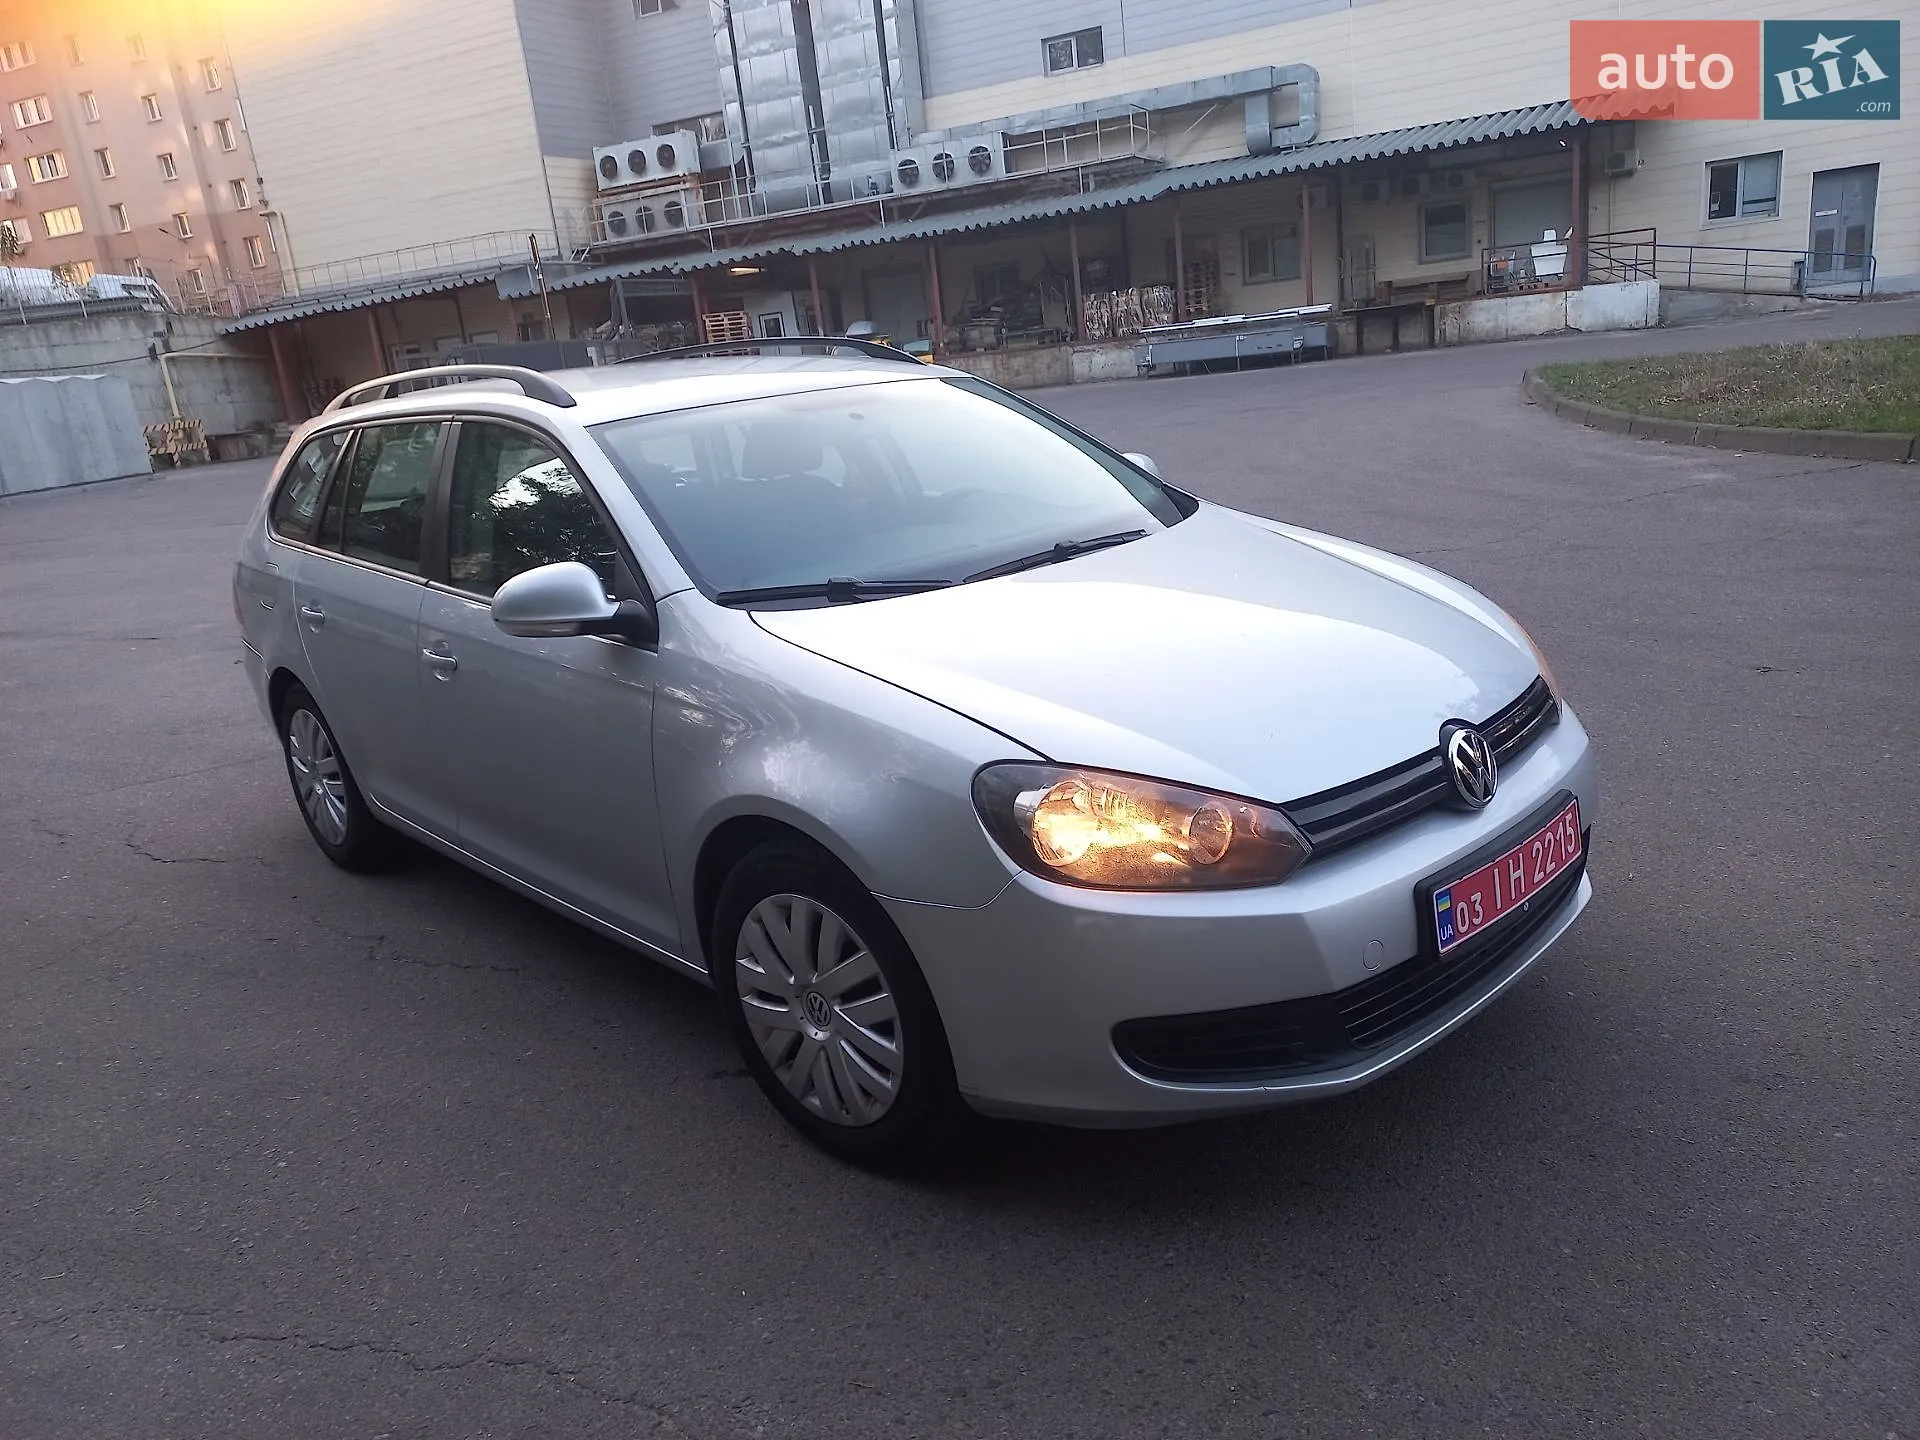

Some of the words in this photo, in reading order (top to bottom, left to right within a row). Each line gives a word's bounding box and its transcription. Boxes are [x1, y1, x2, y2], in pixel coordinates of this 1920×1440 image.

[1456, 891, 1484, 934] 03
[1531, 812, 1576, 885] 2215
[1440, 923, 1454, 940] UA
